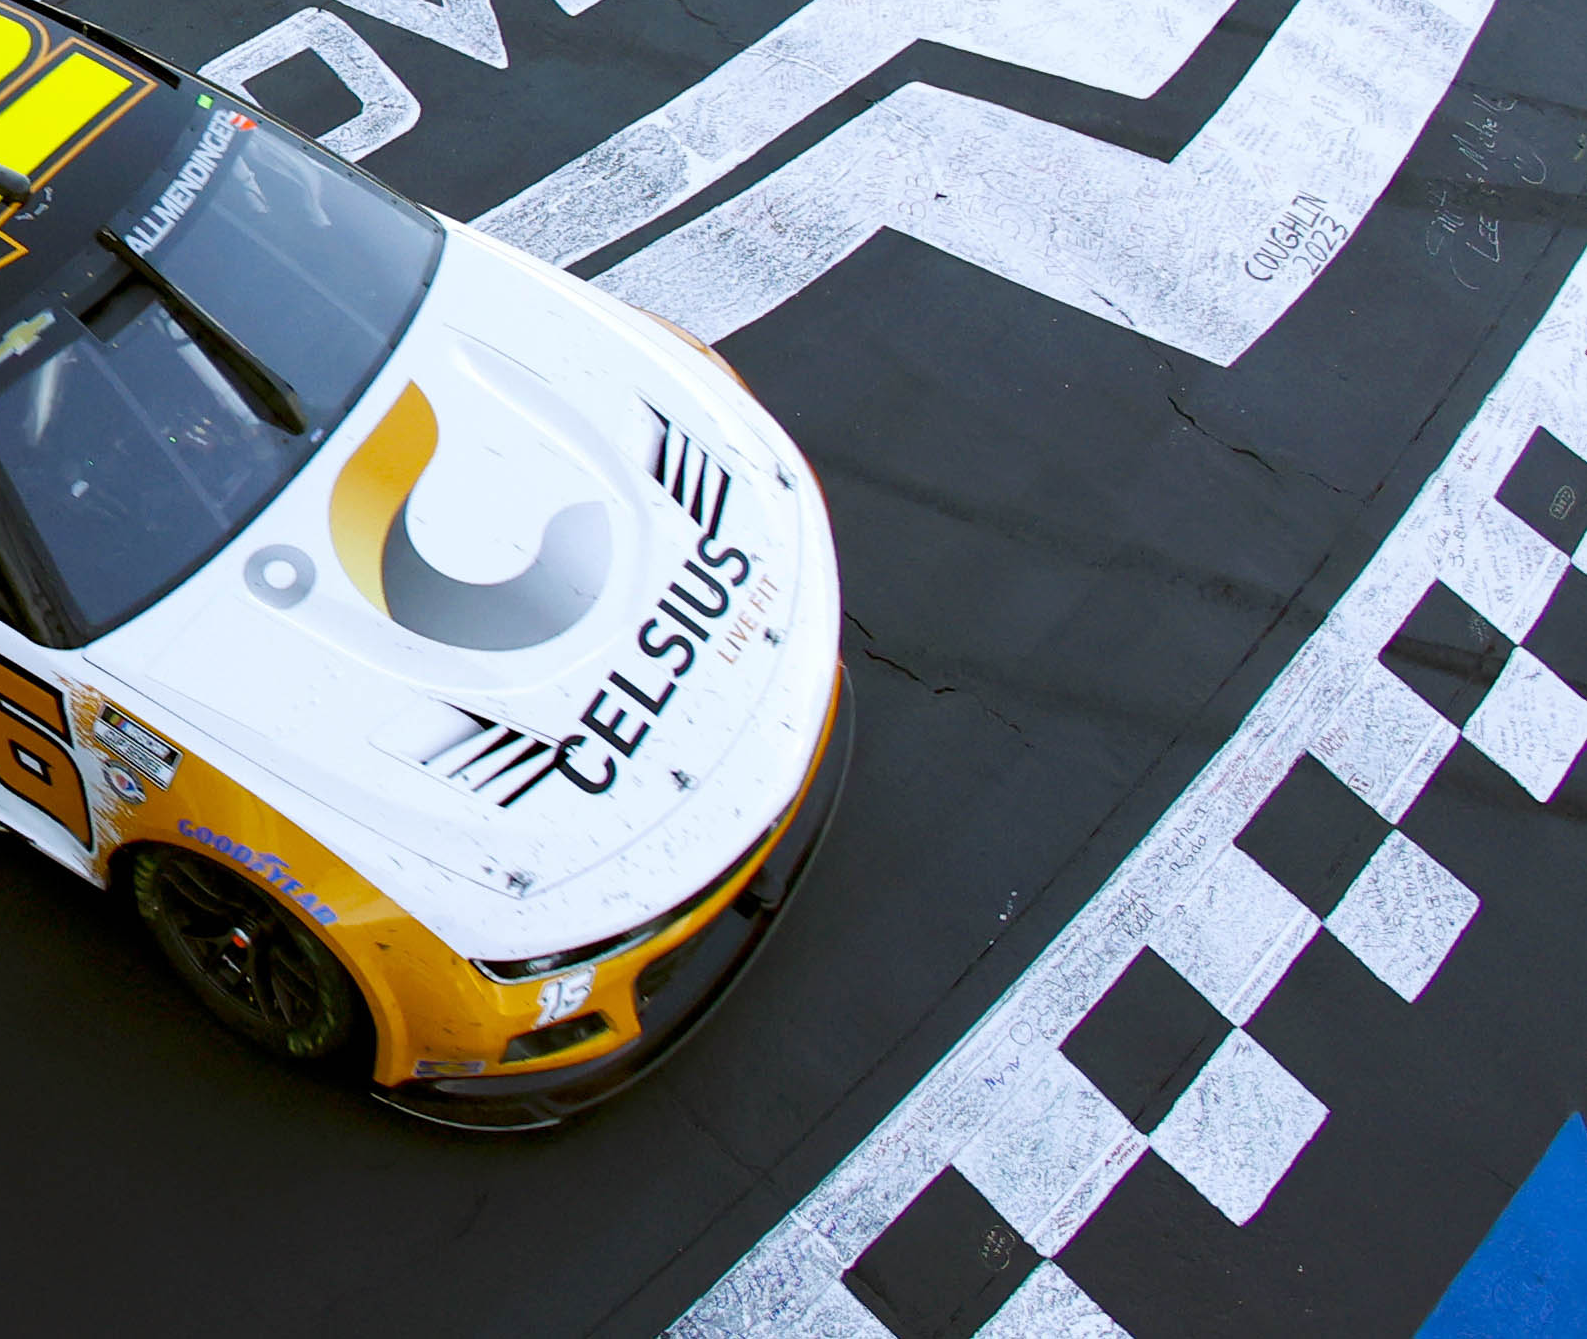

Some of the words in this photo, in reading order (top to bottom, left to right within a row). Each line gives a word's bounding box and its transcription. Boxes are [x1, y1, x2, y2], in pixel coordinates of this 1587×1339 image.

[124, 108, 239, 258] ALLMENDINGER
[1244, 189, 1328, 282] COUGHLIN
[1292, 215, 1349, 276] 2023
[553, 532, 751, 795] CELSIUS
[716, 612, 759, 665] LIVE
[748, 574, 779, 614] FIT
[177, 818, 339, 927] GOODYEAR
